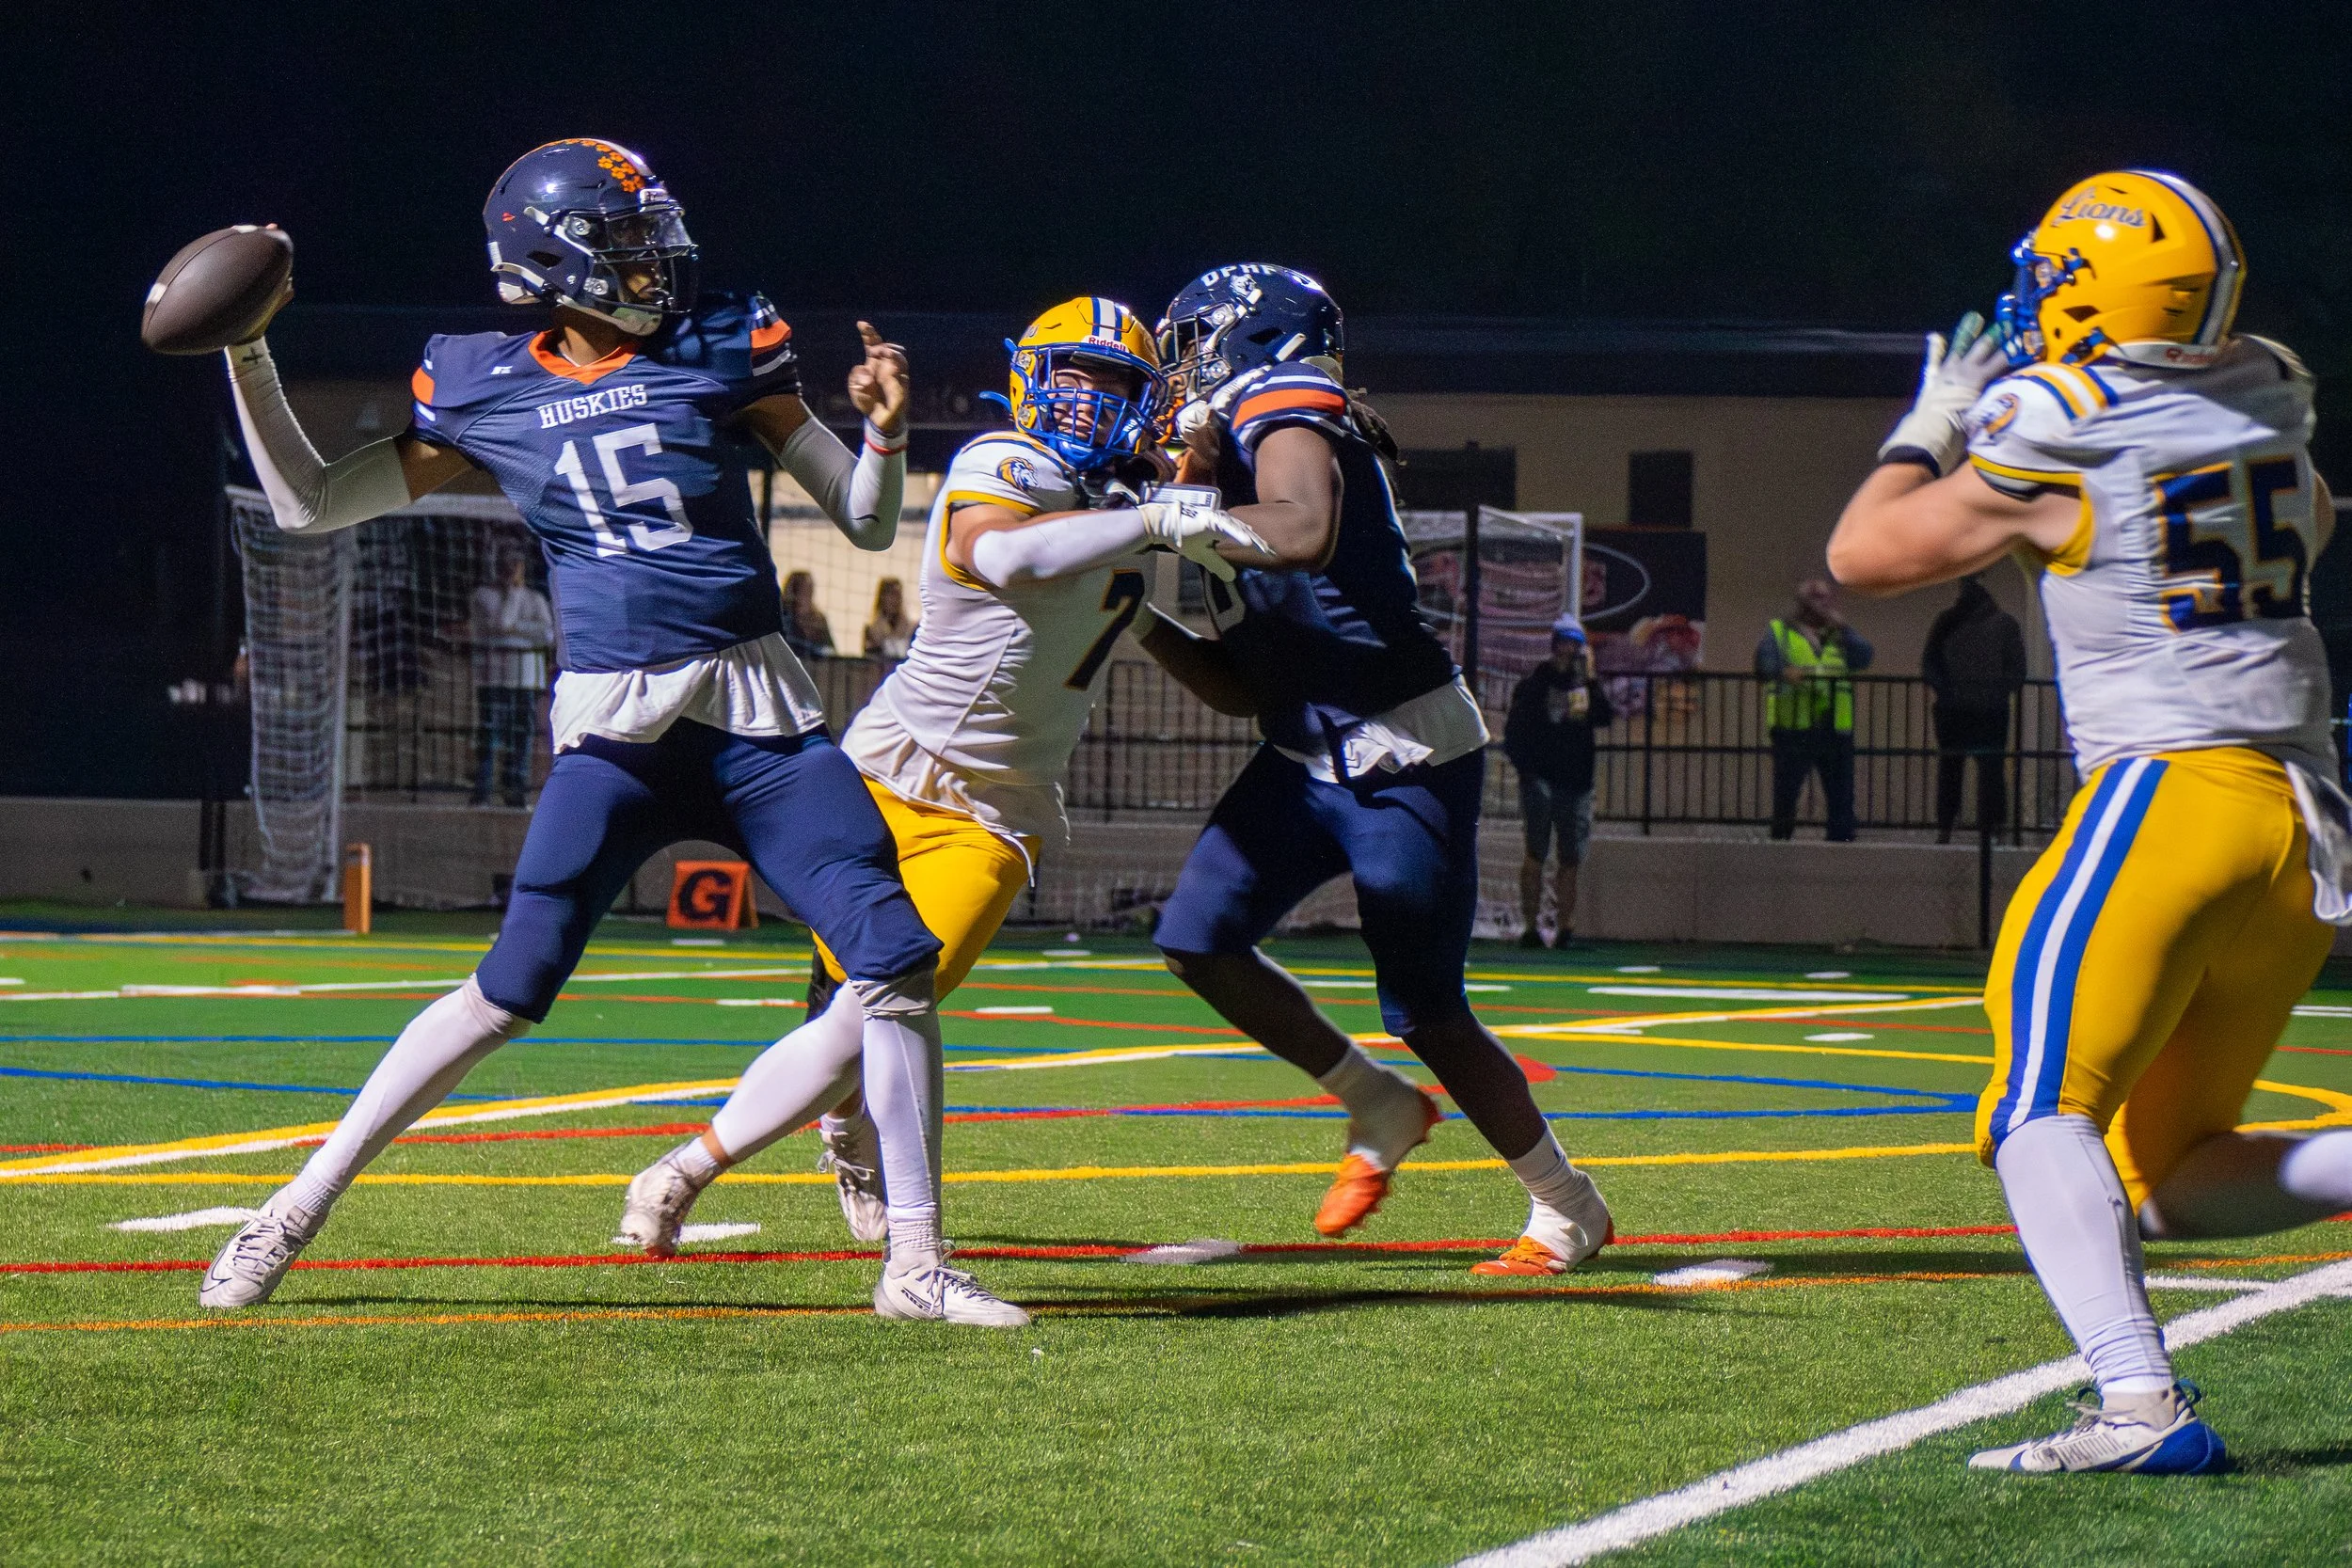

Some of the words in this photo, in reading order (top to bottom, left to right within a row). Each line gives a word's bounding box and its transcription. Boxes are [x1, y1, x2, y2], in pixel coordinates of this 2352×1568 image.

[2050, 186, 2146, 228] Lions
[1089, 337, 1126, 352] Riddell
[536, 384, 648, 429] HUSKIES
[554, 422, 694, 558] 15
[2149, 453, 2307, 634] 55
[1062, 568, 1145, 691] 7
[678, 869, 732, 922] G
